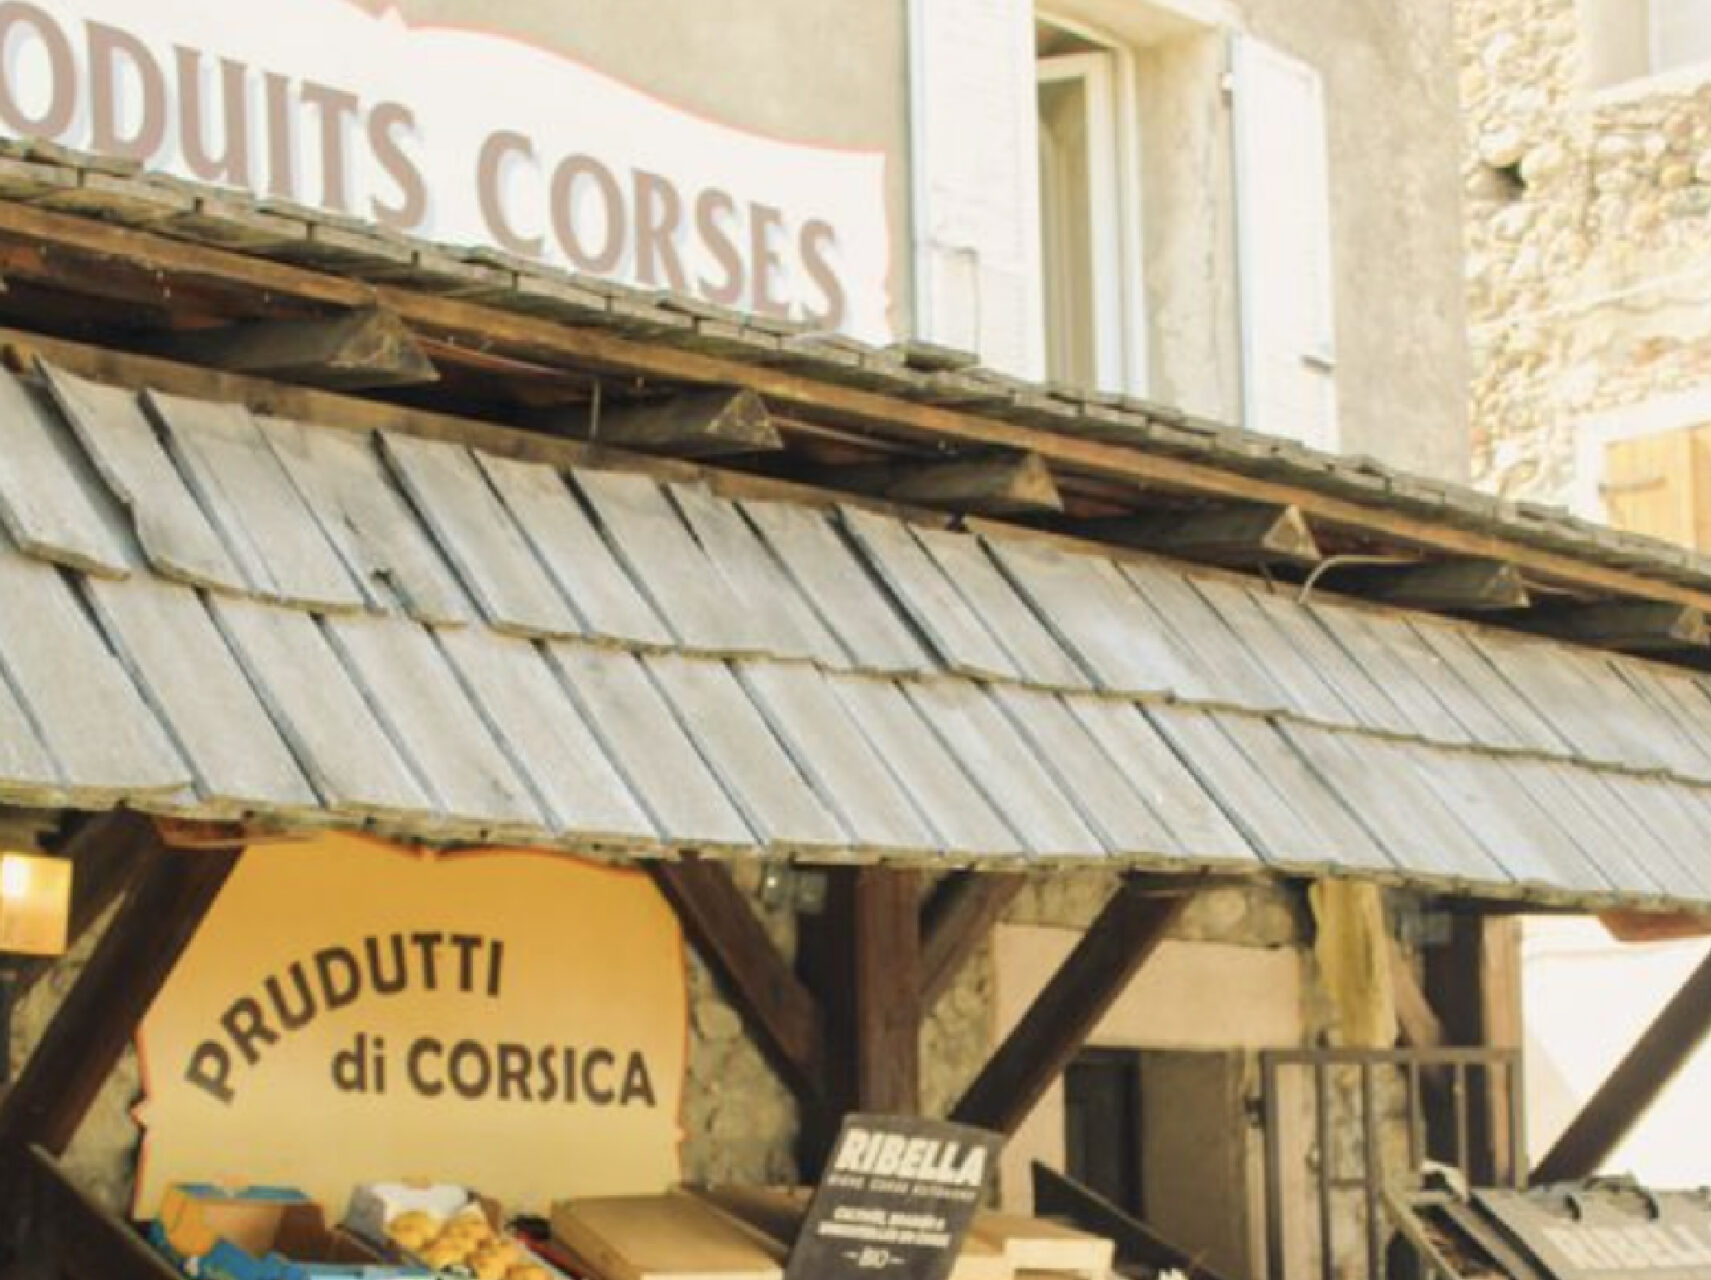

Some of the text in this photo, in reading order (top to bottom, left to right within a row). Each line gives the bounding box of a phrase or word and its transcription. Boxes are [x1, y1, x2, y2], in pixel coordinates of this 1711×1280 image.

[0, 3, 847, 335] ODUITS CORSES
[184, 931, 504, 1104] PRUDUTTI
[331, 1032, 656, 1107] di CORSICA
